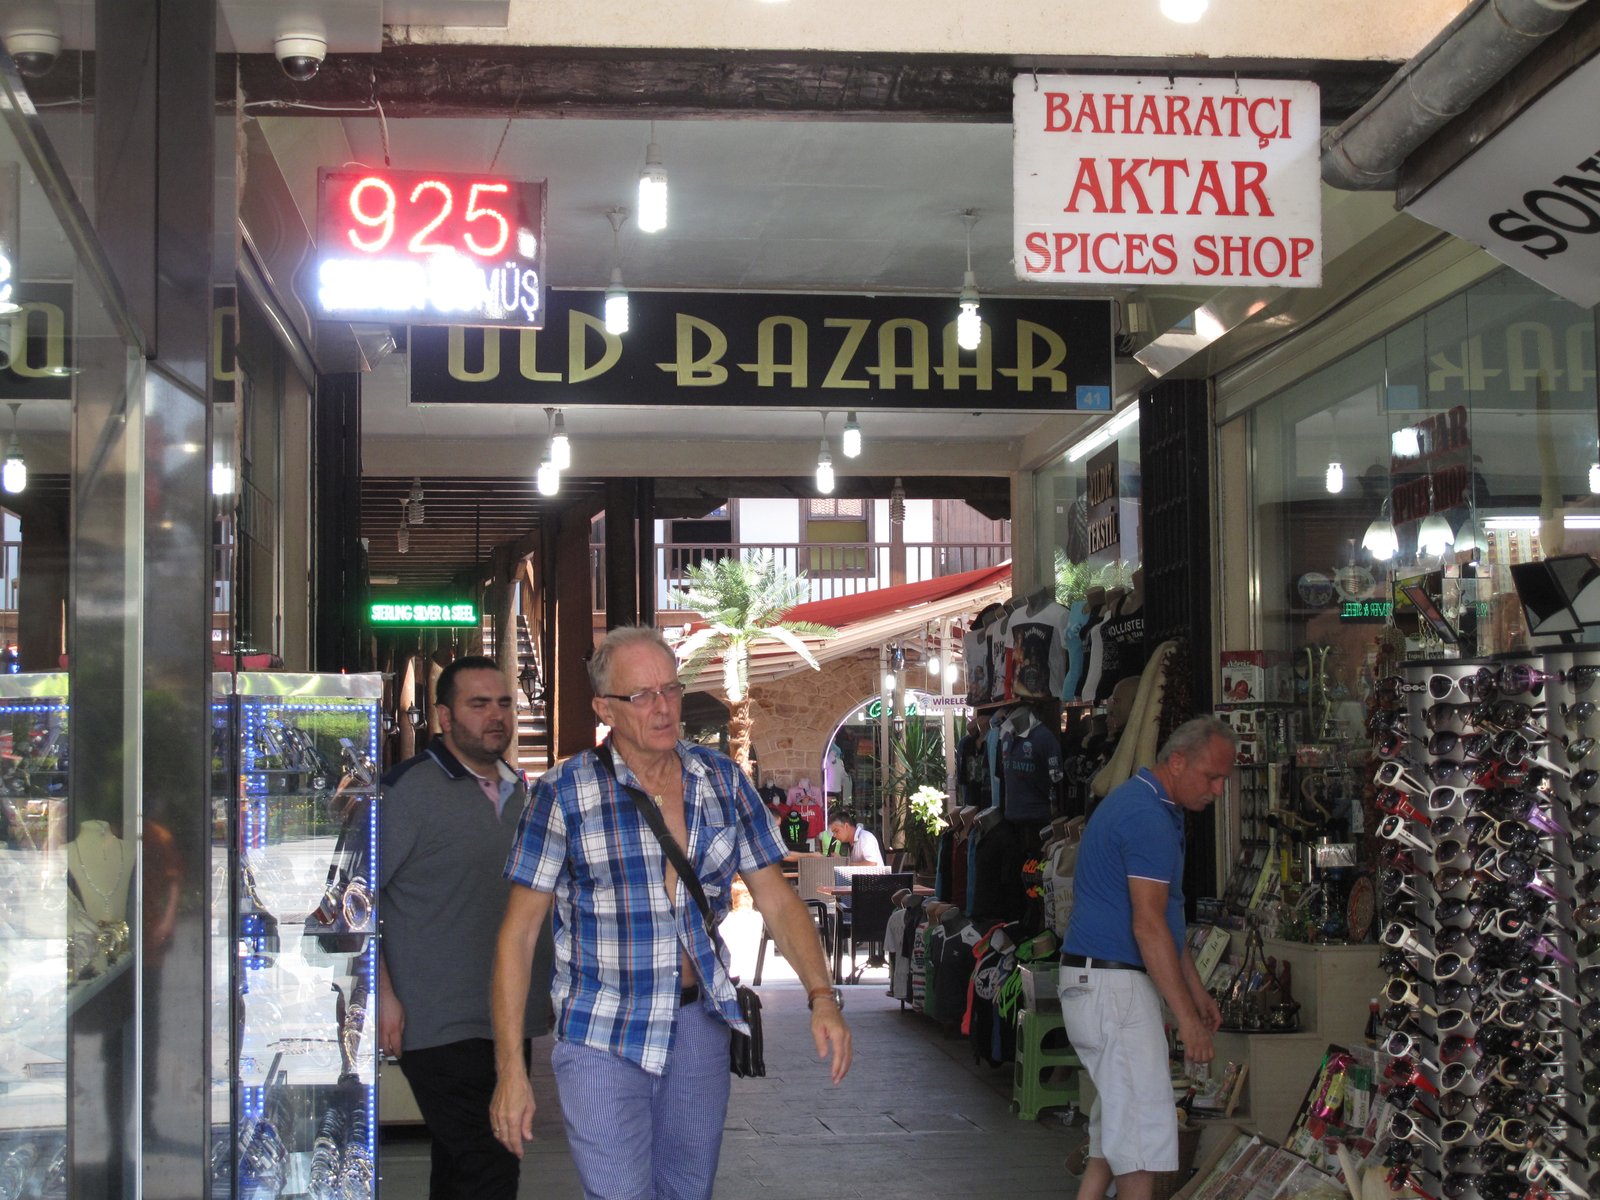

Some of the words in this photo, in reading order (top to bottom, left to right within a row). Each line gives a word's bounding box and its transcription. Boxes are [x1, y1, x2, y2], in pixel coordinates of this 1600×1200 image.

[1044, 92, 1292, 150] BAHARATÇI
[348, 177, 509, 257] 925
[1063, 156, 1275, 217] AKTAR
[1489, 149, 1600, 260] SON
[1024, 231, 1178, 275] SPICES
[1192, 234, 1315, 278] SHOP
[655, 313, 1068, 393] BAZAAR
